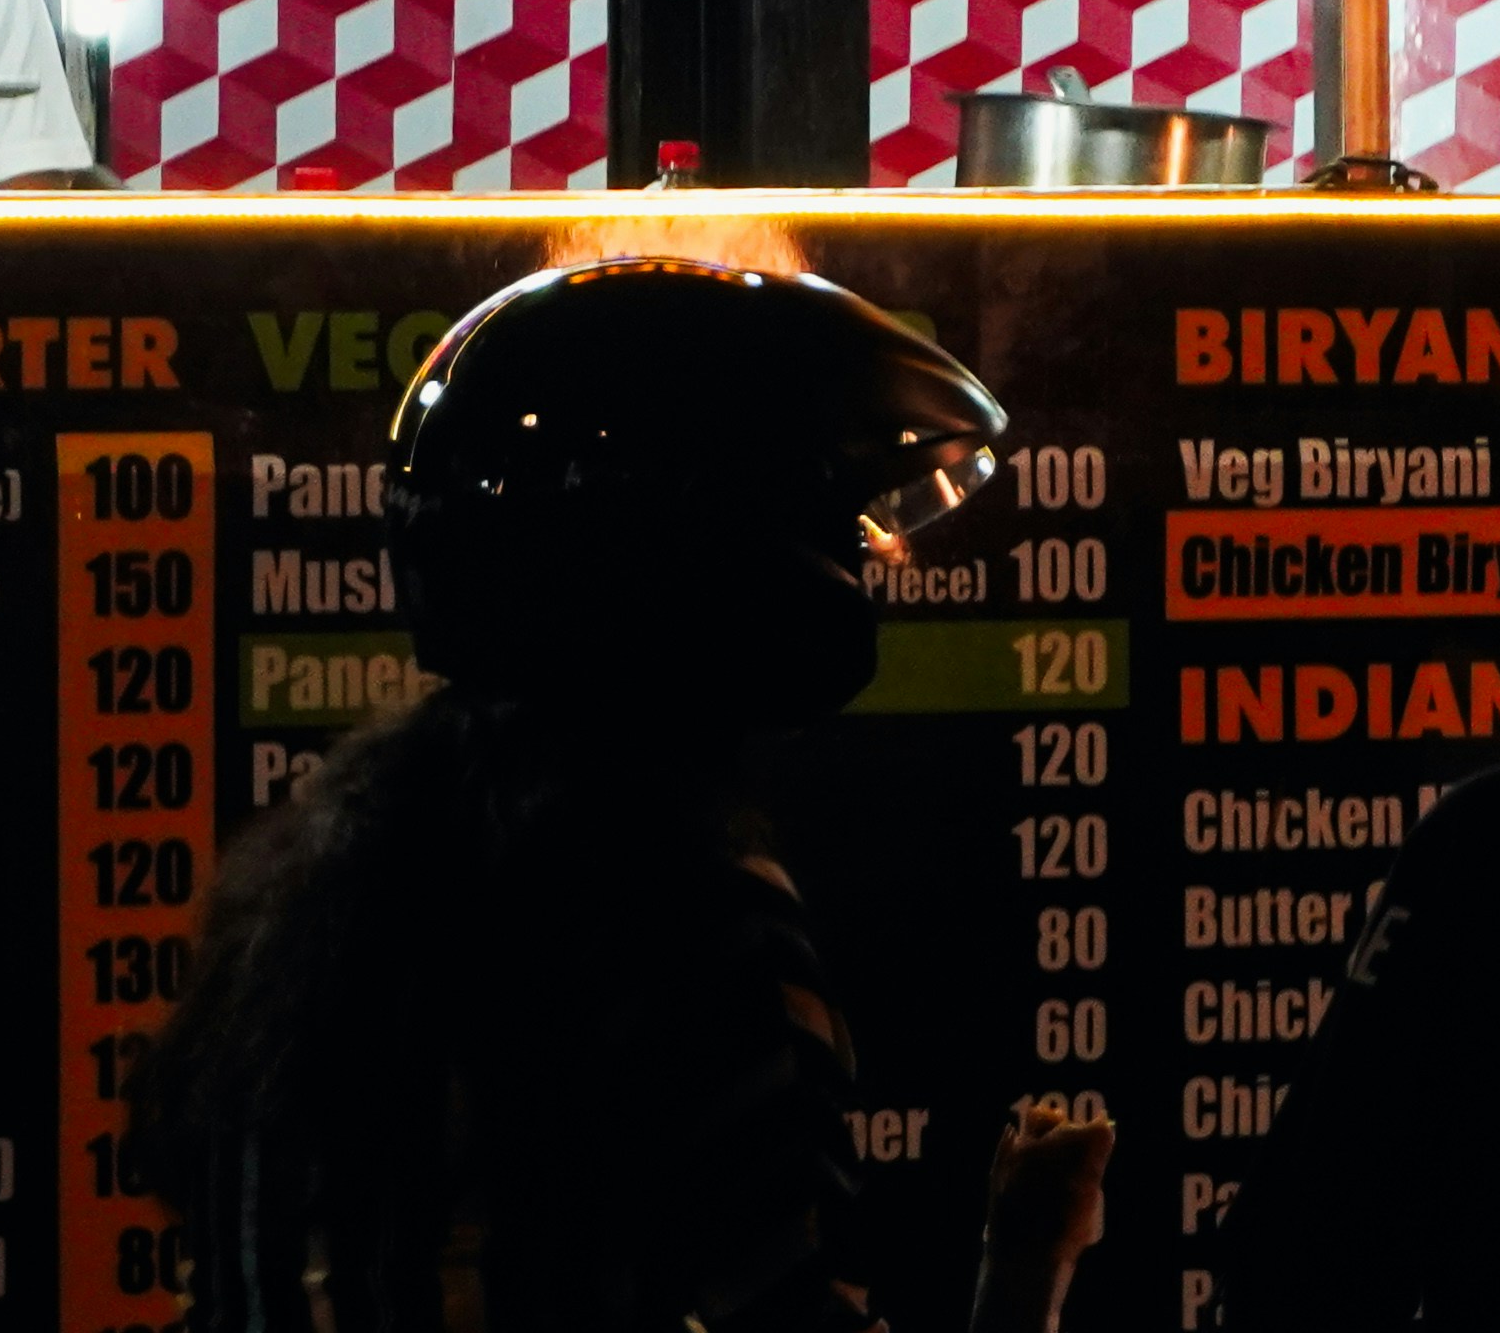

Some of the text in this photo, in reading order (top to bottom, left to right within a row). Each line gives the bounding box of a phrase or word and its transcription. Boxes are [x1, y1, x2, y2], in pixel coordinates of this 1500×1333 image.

[85, 452, 194, 521] 100
[1009, 443, 1108, 512] 100
[1178, 435, 1493, 507] Veg Biryani
[85, 550, 194, 618] 150
[1009, 536, 1108, 605] 100
[1181, 534, 1401, 601] Chicken
[85, 647, 194, 714] 120
[1012, 630, 1108, 697] 120
[86, 743, 194, 810] 120
[1012, 722, 1108, 789] 120
[1012, 813, 1109, 881] 120
[1181, 786, 1402, 855] Chicken
[87, 839, 194, 908] 120
[1035, 904, 1109, 973] 80
[1181, 884, 1353, 950] Butter
[1034, 996, 1109, 1066] 60
